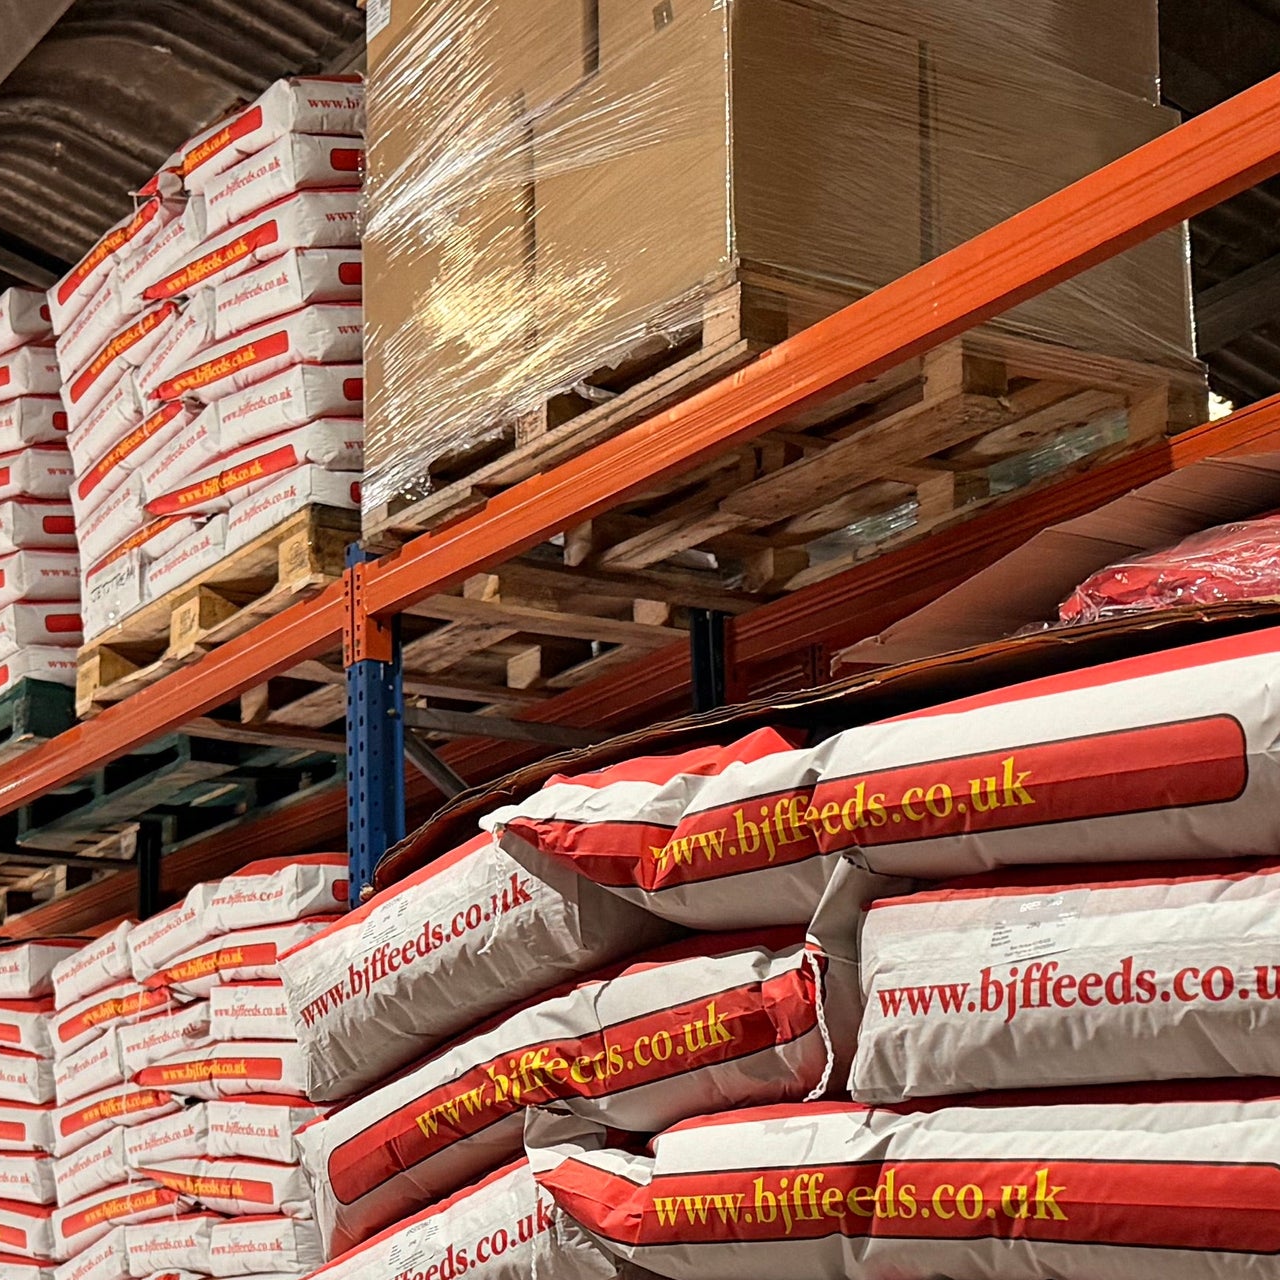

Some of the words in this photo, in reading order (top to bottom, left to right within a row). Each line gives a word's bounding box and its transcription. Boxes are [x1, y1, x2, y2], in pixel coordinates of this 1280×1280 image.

[650, 757, 1035, 872] www.bjffeeds.co.uk
[299, 872, 532, 1028] www.bjffeeds.co.uk
[654, 1169, 1068, 1233] www.bjffeeds.co.uk
